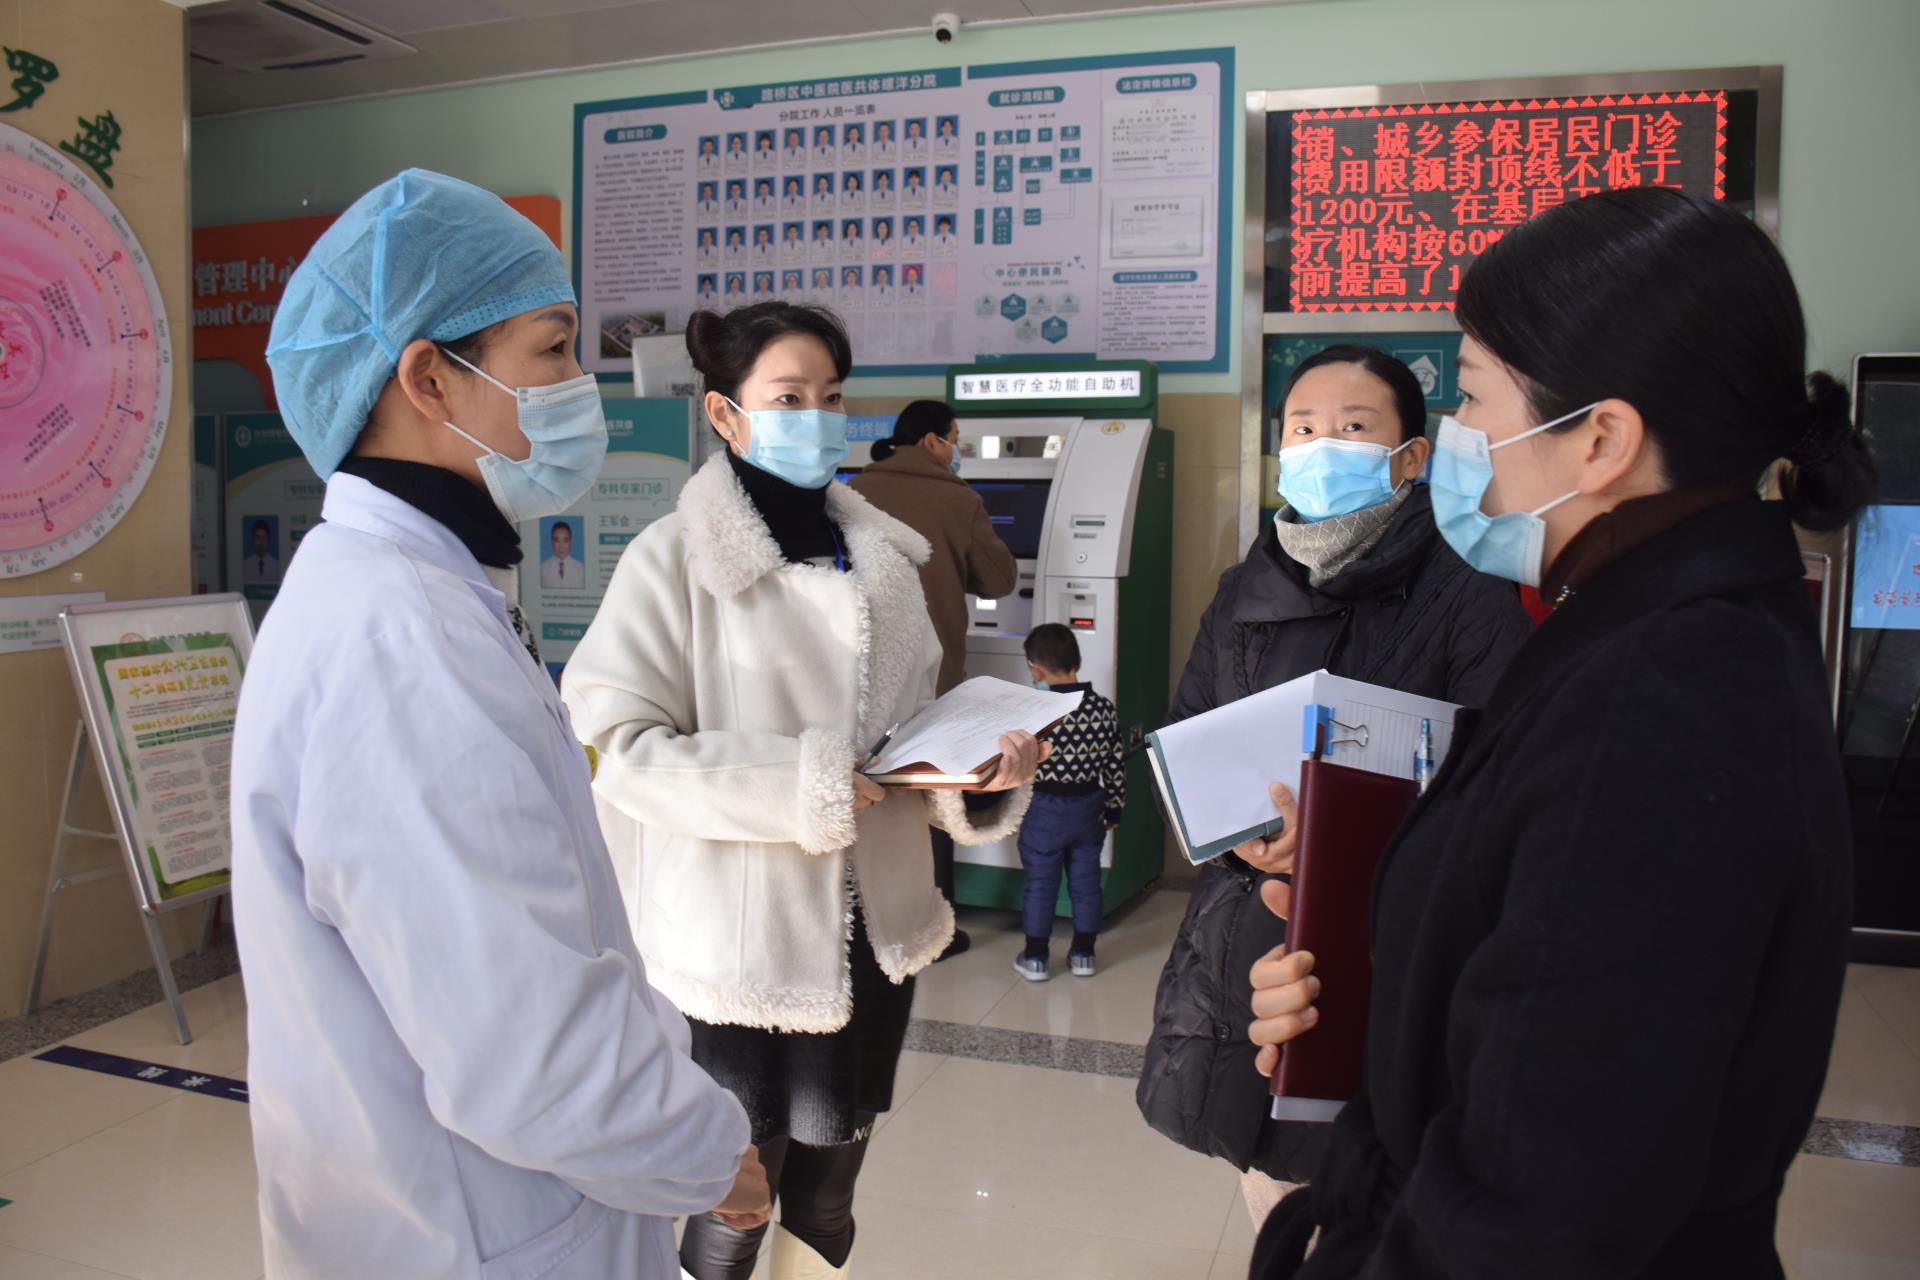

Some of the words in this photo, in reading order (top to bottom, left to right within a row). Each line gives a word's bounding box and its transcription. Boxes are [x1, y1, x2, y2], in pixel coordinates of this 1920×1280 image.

[761, 73, 937, 102] 路桥区中医院医共体螺洋分院
[999, 89, 1055, 104] 就诊流程图
[616, 127, 654, 142] 医院简介
[1301, 110, 1683, 160] 销、城乡参保居民门诊
[1301, 148, 1681, 195] 费用限额封顶线不低于
[961, 376, 1136, 394] 智慧医疗全功能自助机
[598, 482, 663, 496] 专科专家门诊
